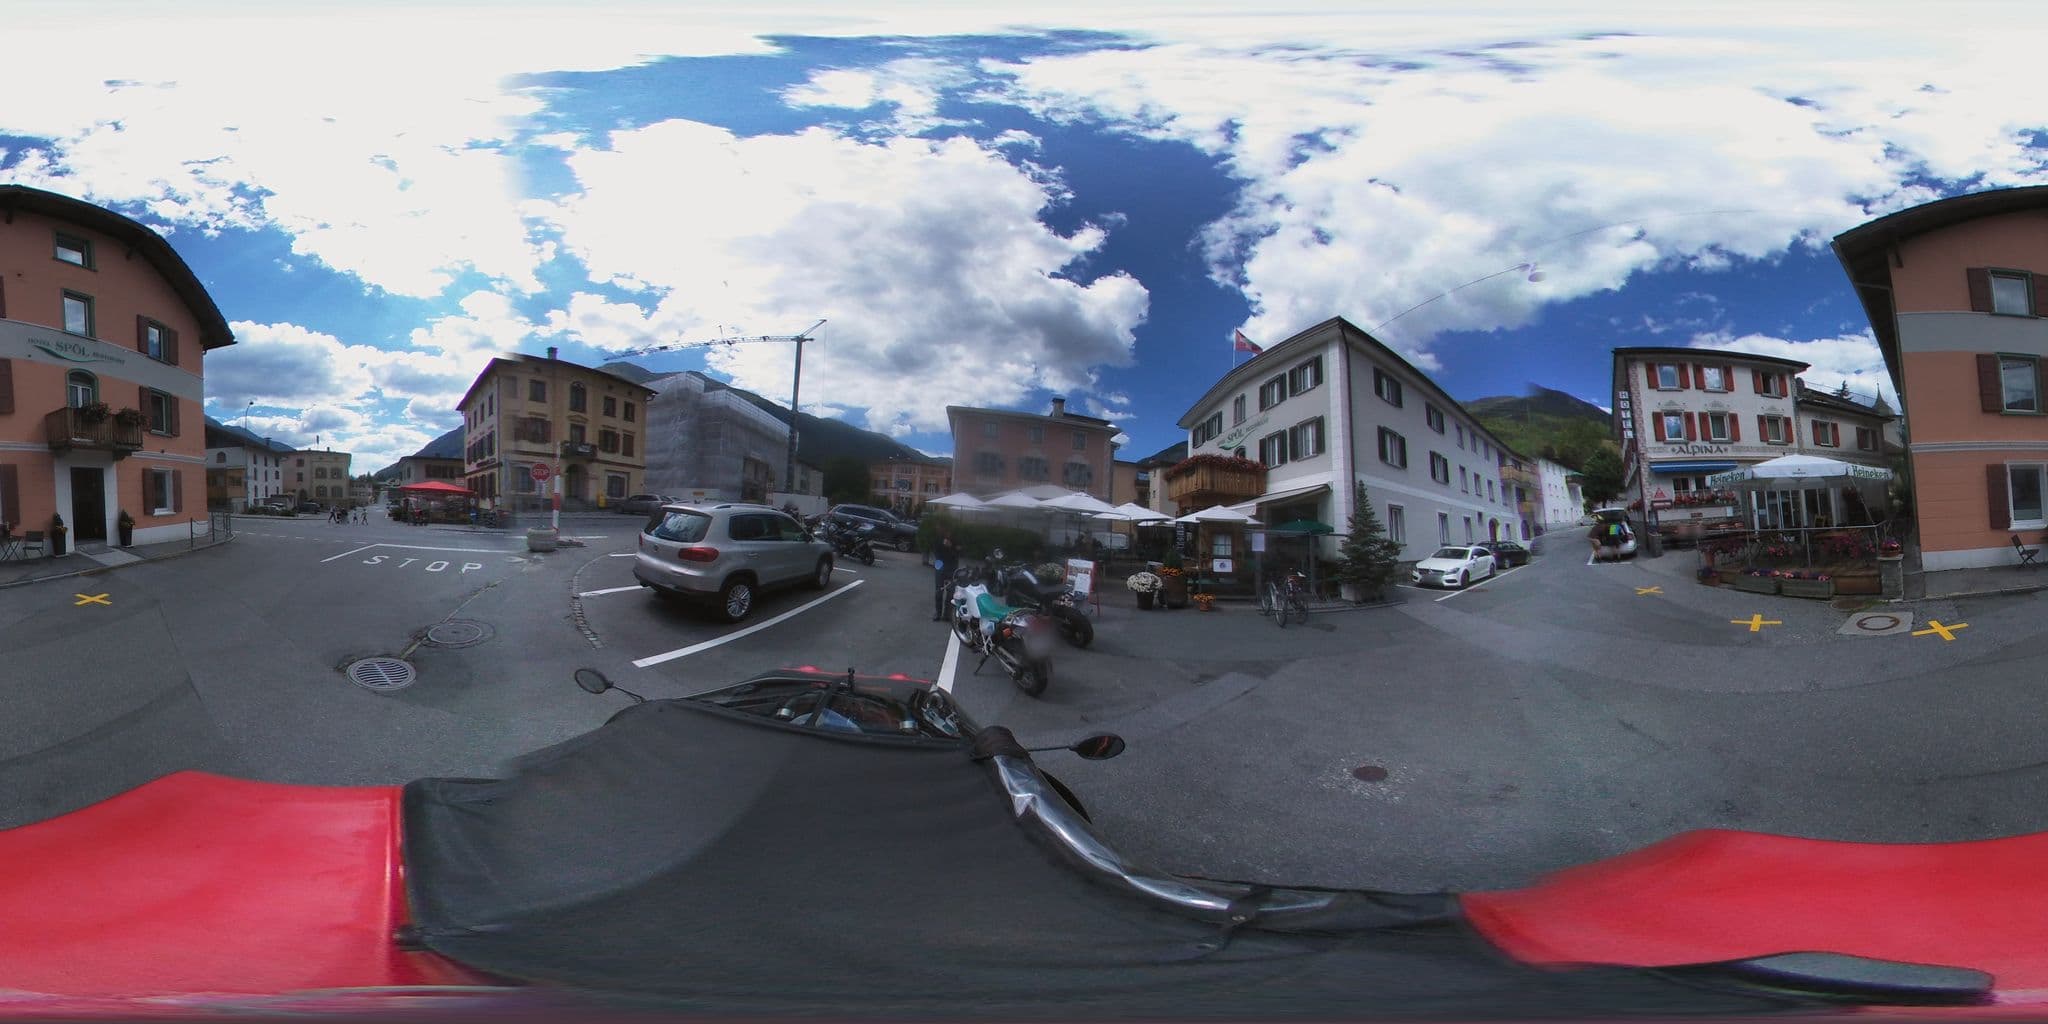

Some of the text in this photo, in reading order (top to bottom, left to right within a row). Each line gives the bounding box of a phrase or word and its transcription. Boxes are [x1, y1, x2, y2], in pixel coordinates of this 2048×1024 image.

[1619, 391, 1633, 438] HOTEL
[1675, 443, 1724, 456] ALPINA
[533, 467, 549, 476] STOP
[1710, 470, 1745, 486] Heineken
[1851, 464, 1889, 480] Heineken
[362, 555, 482, 574] STOP
